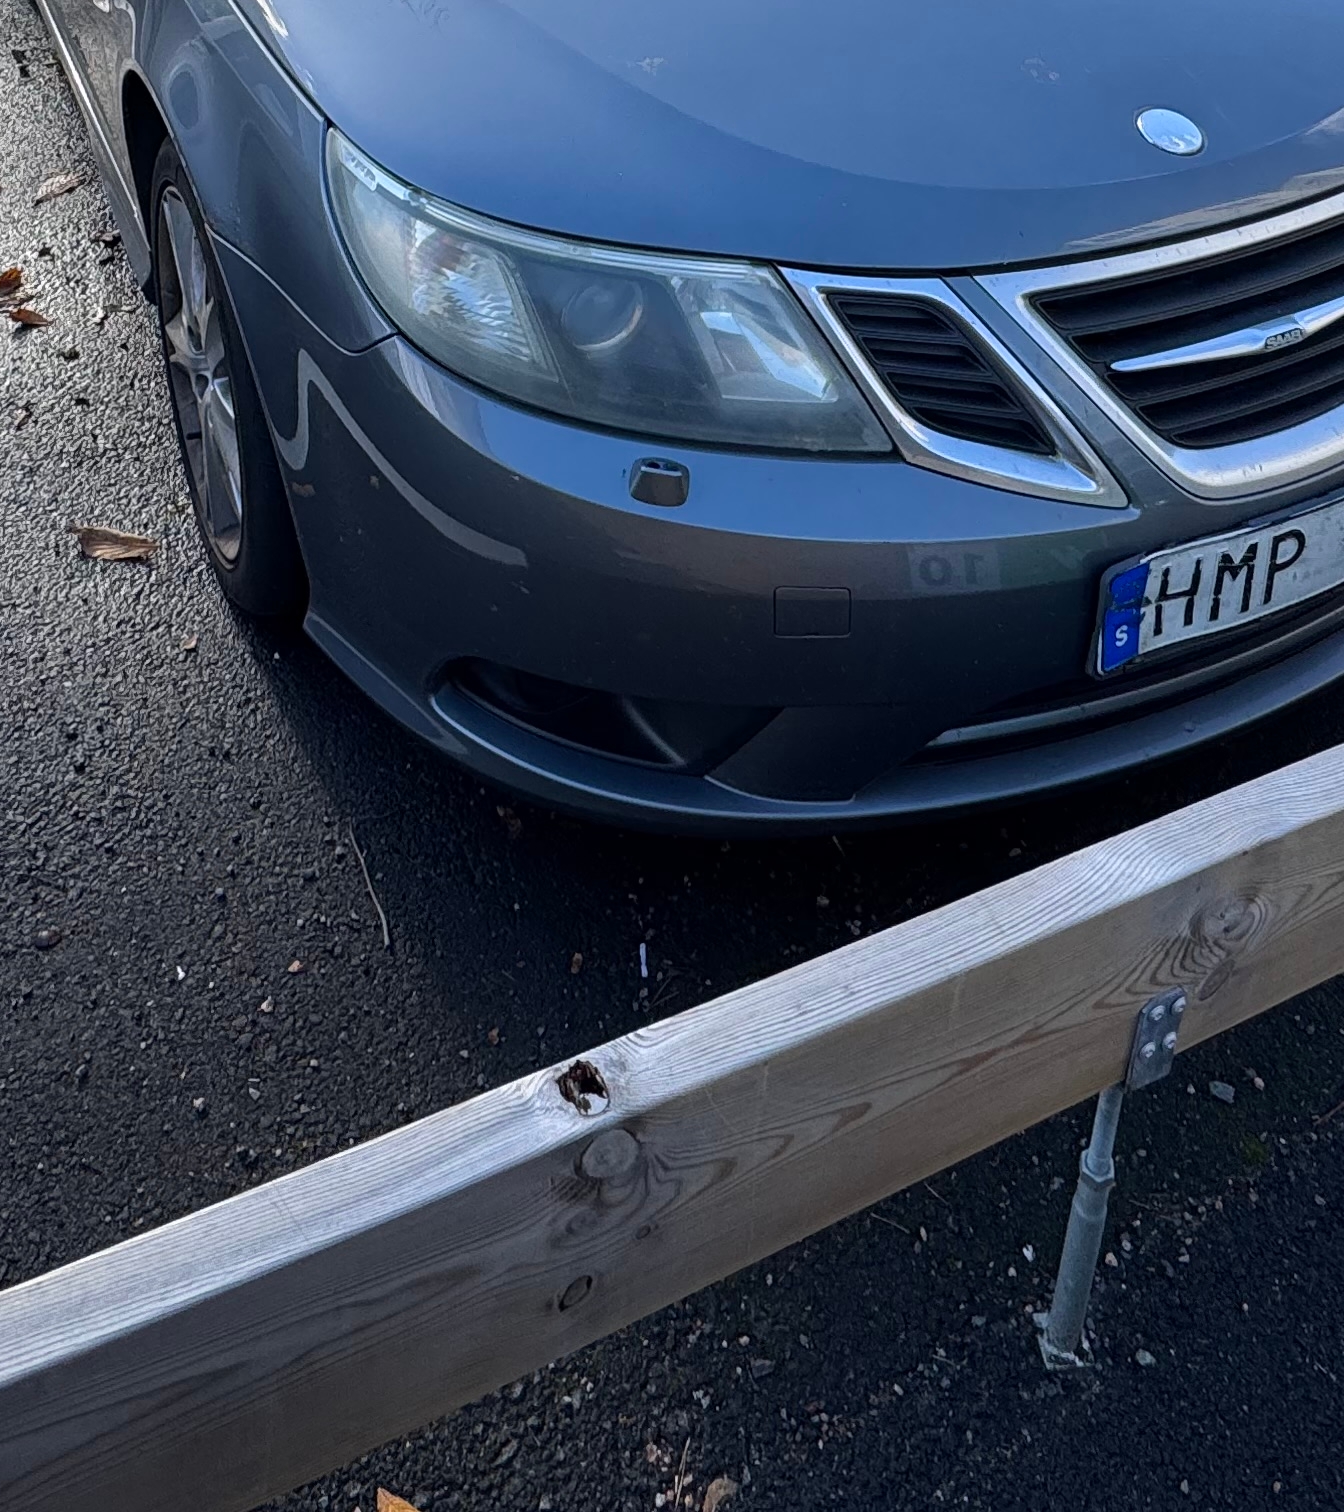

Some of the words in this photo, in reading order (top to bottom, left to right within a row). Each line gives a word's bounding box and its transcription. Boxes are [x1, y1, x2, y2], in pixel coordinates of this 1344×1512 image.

[1266, 328, 1301, 349] SAAB
[1152, 527, 1306, 637] HMP
[1114, 625, 1129, 648] S
